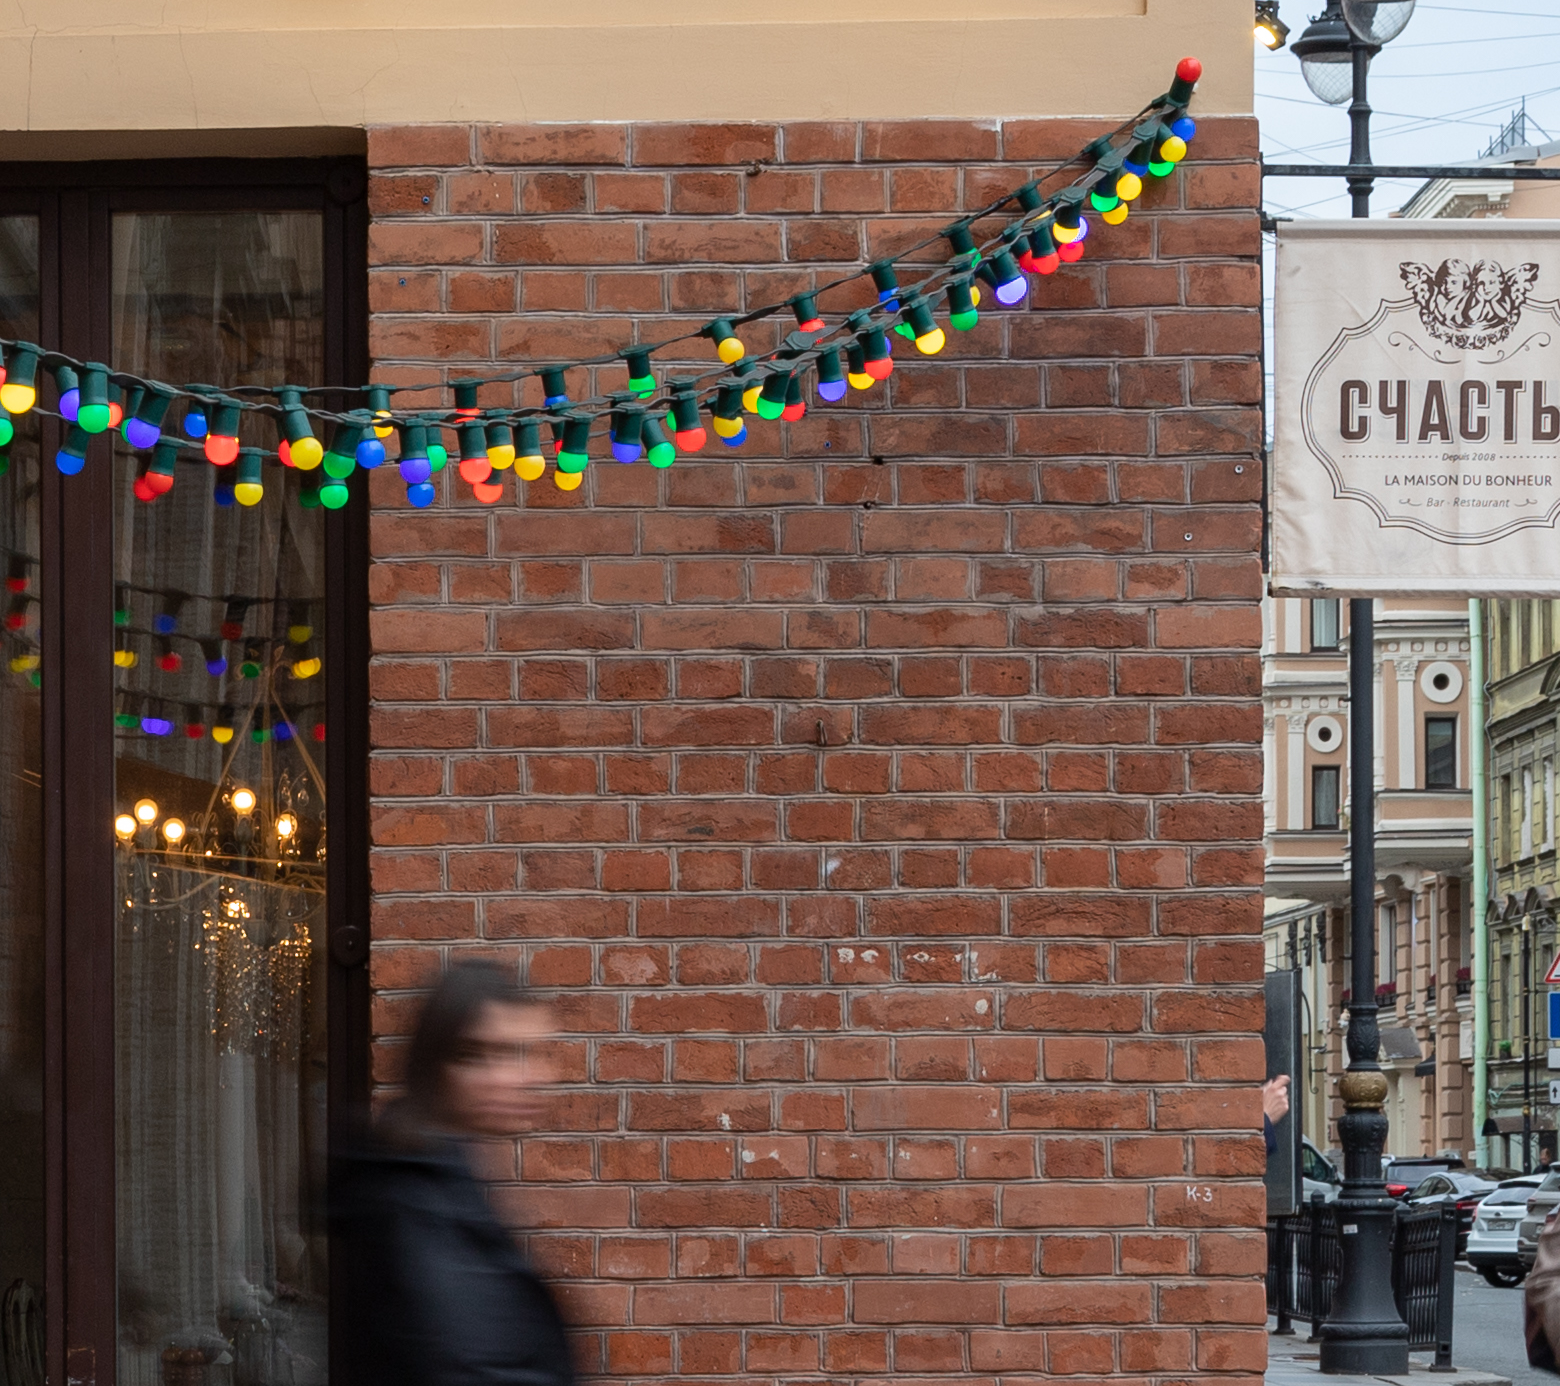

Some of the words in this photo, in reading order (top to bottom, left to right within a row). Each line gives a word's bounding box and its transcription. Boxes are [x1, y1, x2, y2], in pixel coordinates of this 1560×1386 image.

[1442, 452, 1470, 463] Depuis
[1472, 452, 1496, 462] 2008
[1384, 475, 1401, 486] LA
[1404, 474, 1458, 486] MAISON
[1463, 475, 1482, 486] DU
[1486, 475, 1553, 486] BONHEUR
[1426, 497, 1444, 508] Bar
[1453, 496, 1510, 508] Restaurant
